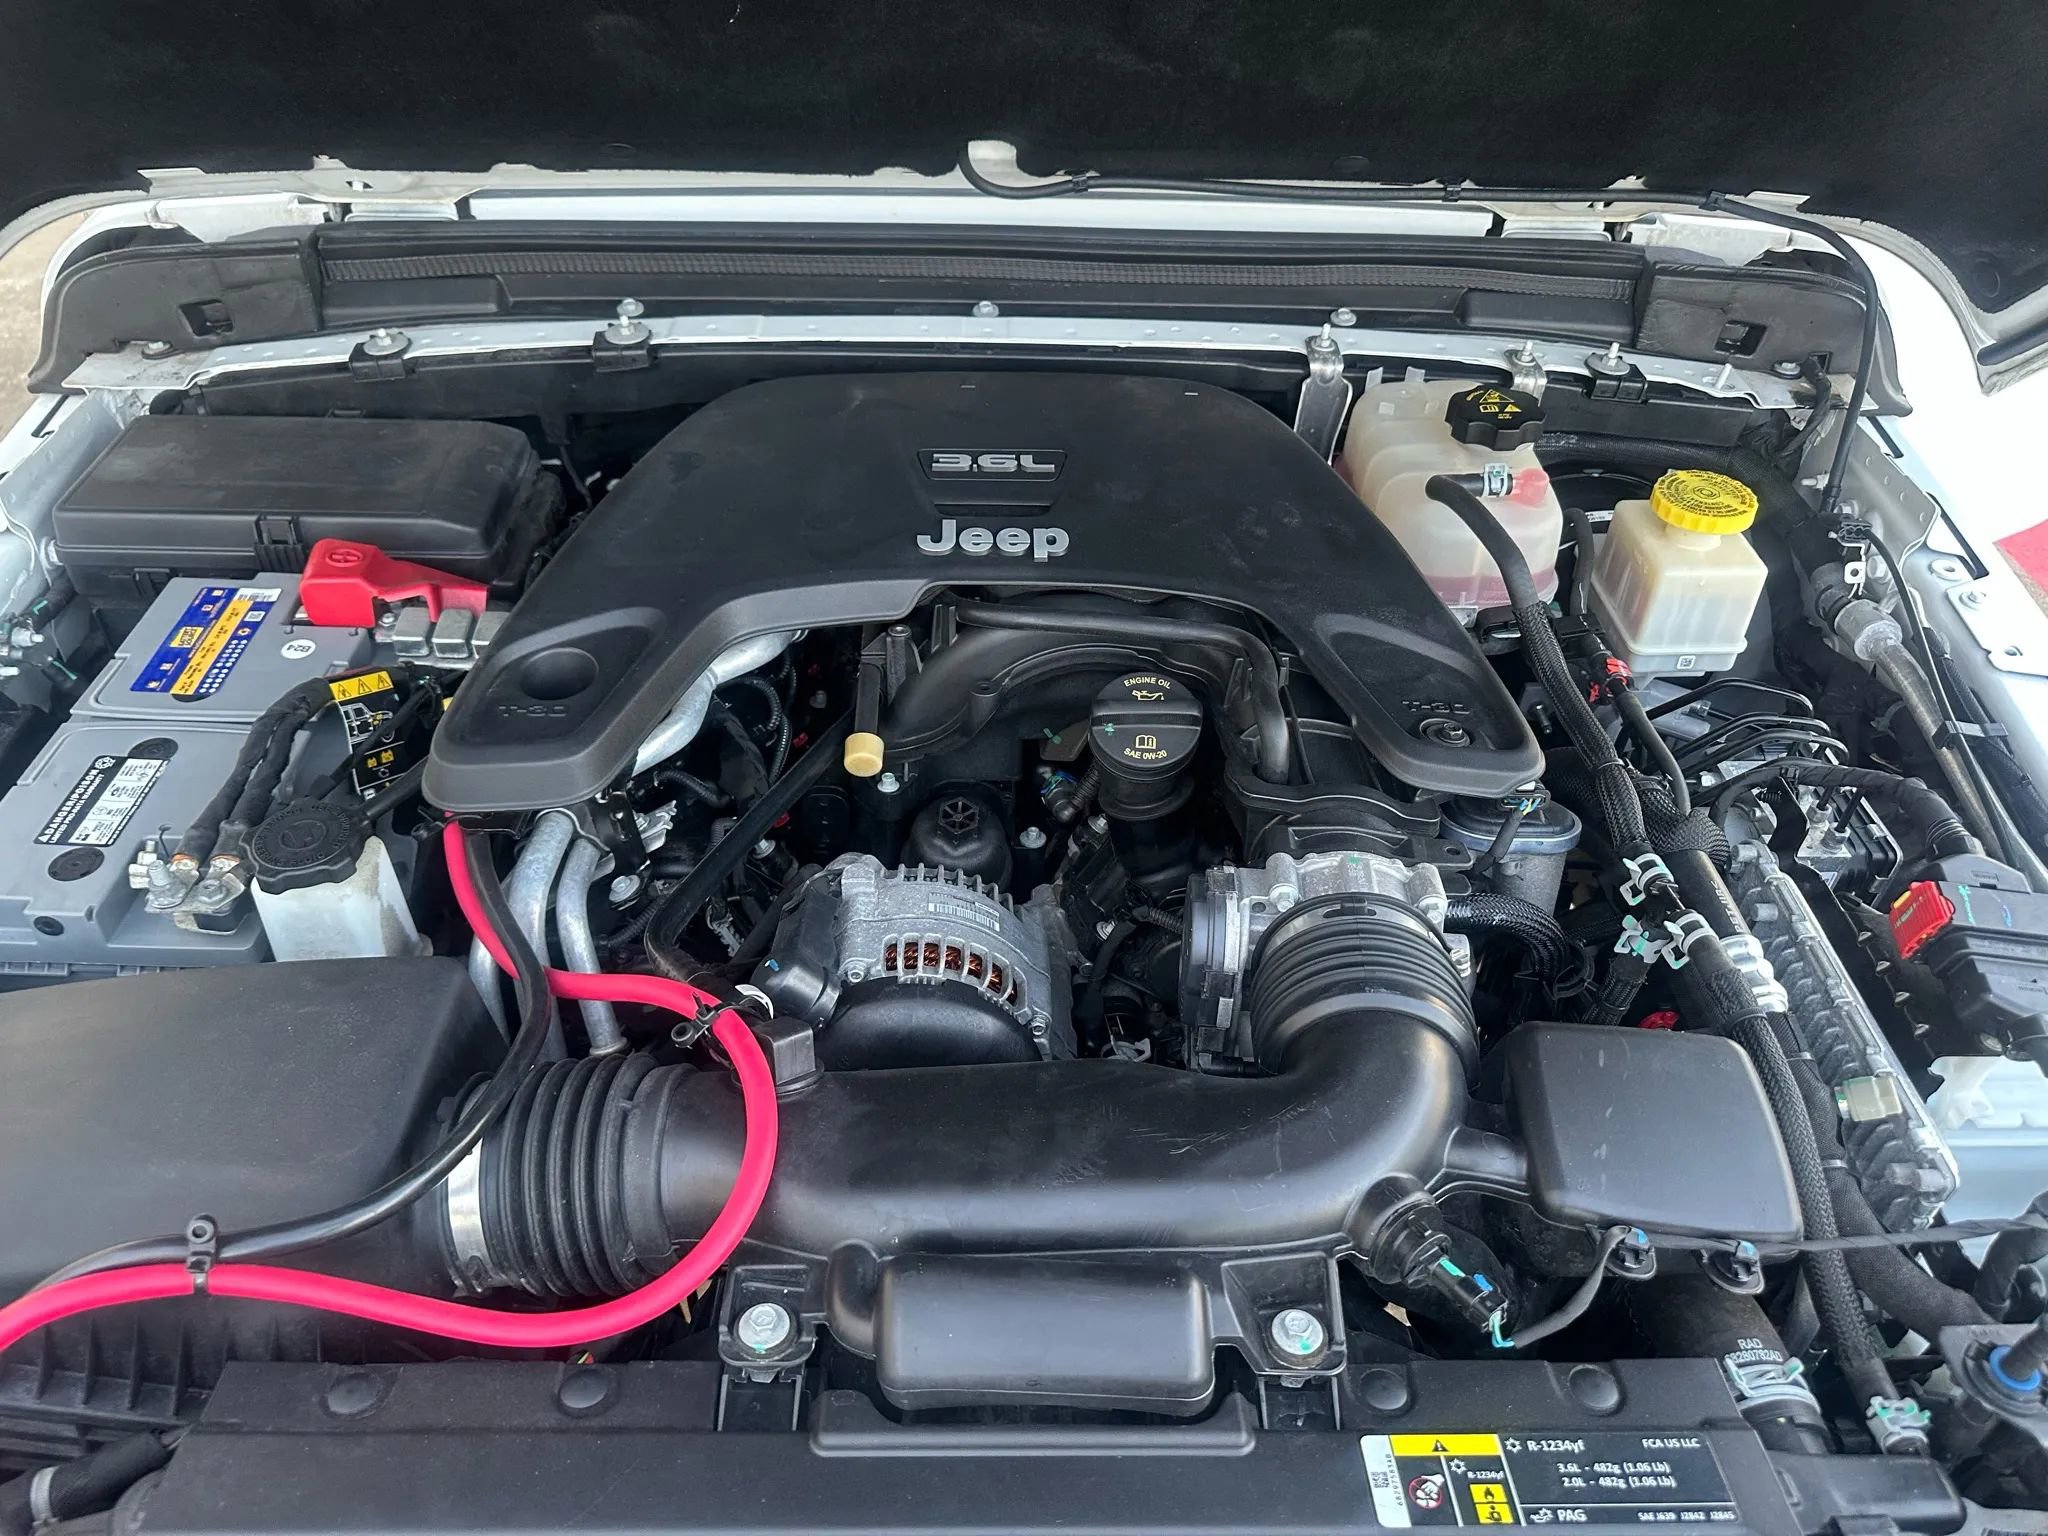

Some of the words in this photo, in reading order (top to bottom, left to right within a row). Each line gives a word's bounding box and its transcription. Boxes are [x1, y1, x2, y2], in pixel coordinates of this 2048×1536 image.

[932, 453, 1055, 472] 3.6L
[917, 519, 1069, 562] Jeep
[286, 644, 312, 652] B24
[1123, 676, 1157, 687] ENGINE
[1158, 679, 1171, 690] OIL
[1123, 748, 1141, 759] SAE
[1143, 749, 1168, 760] 0W-20
[1737, 1338, 1762, 1350] RAD
[1527, 1439, 1586, 1454] R-1234yf
[1642, 1438, 1663, 1449] FCA
[1664, 1438, 1680, 1448] US
[1682, 1438, 1701, 1448] LLC
[1557, 1463, 1581, 1473] 3.6L
[1593, 1462, 1621, 1475] 482g
[1623, 1462, 1650, 1474] (1.06
[1652, 1462, 1671, 1473] Lb)
[1467, 1470, 1504, 1480] R-1234yf
[1563, 1477, 1586, 1487] 2.0L
[1599, 1476, 1626, 1489] 482g
[1629, 1476, 1656, 1489] (1.06
[1658, 1476, 1677, 1488] Lb)
[1557, 1510, 1587, 1522] PAG
[1638, 1511, 1655, 1520] SAE
